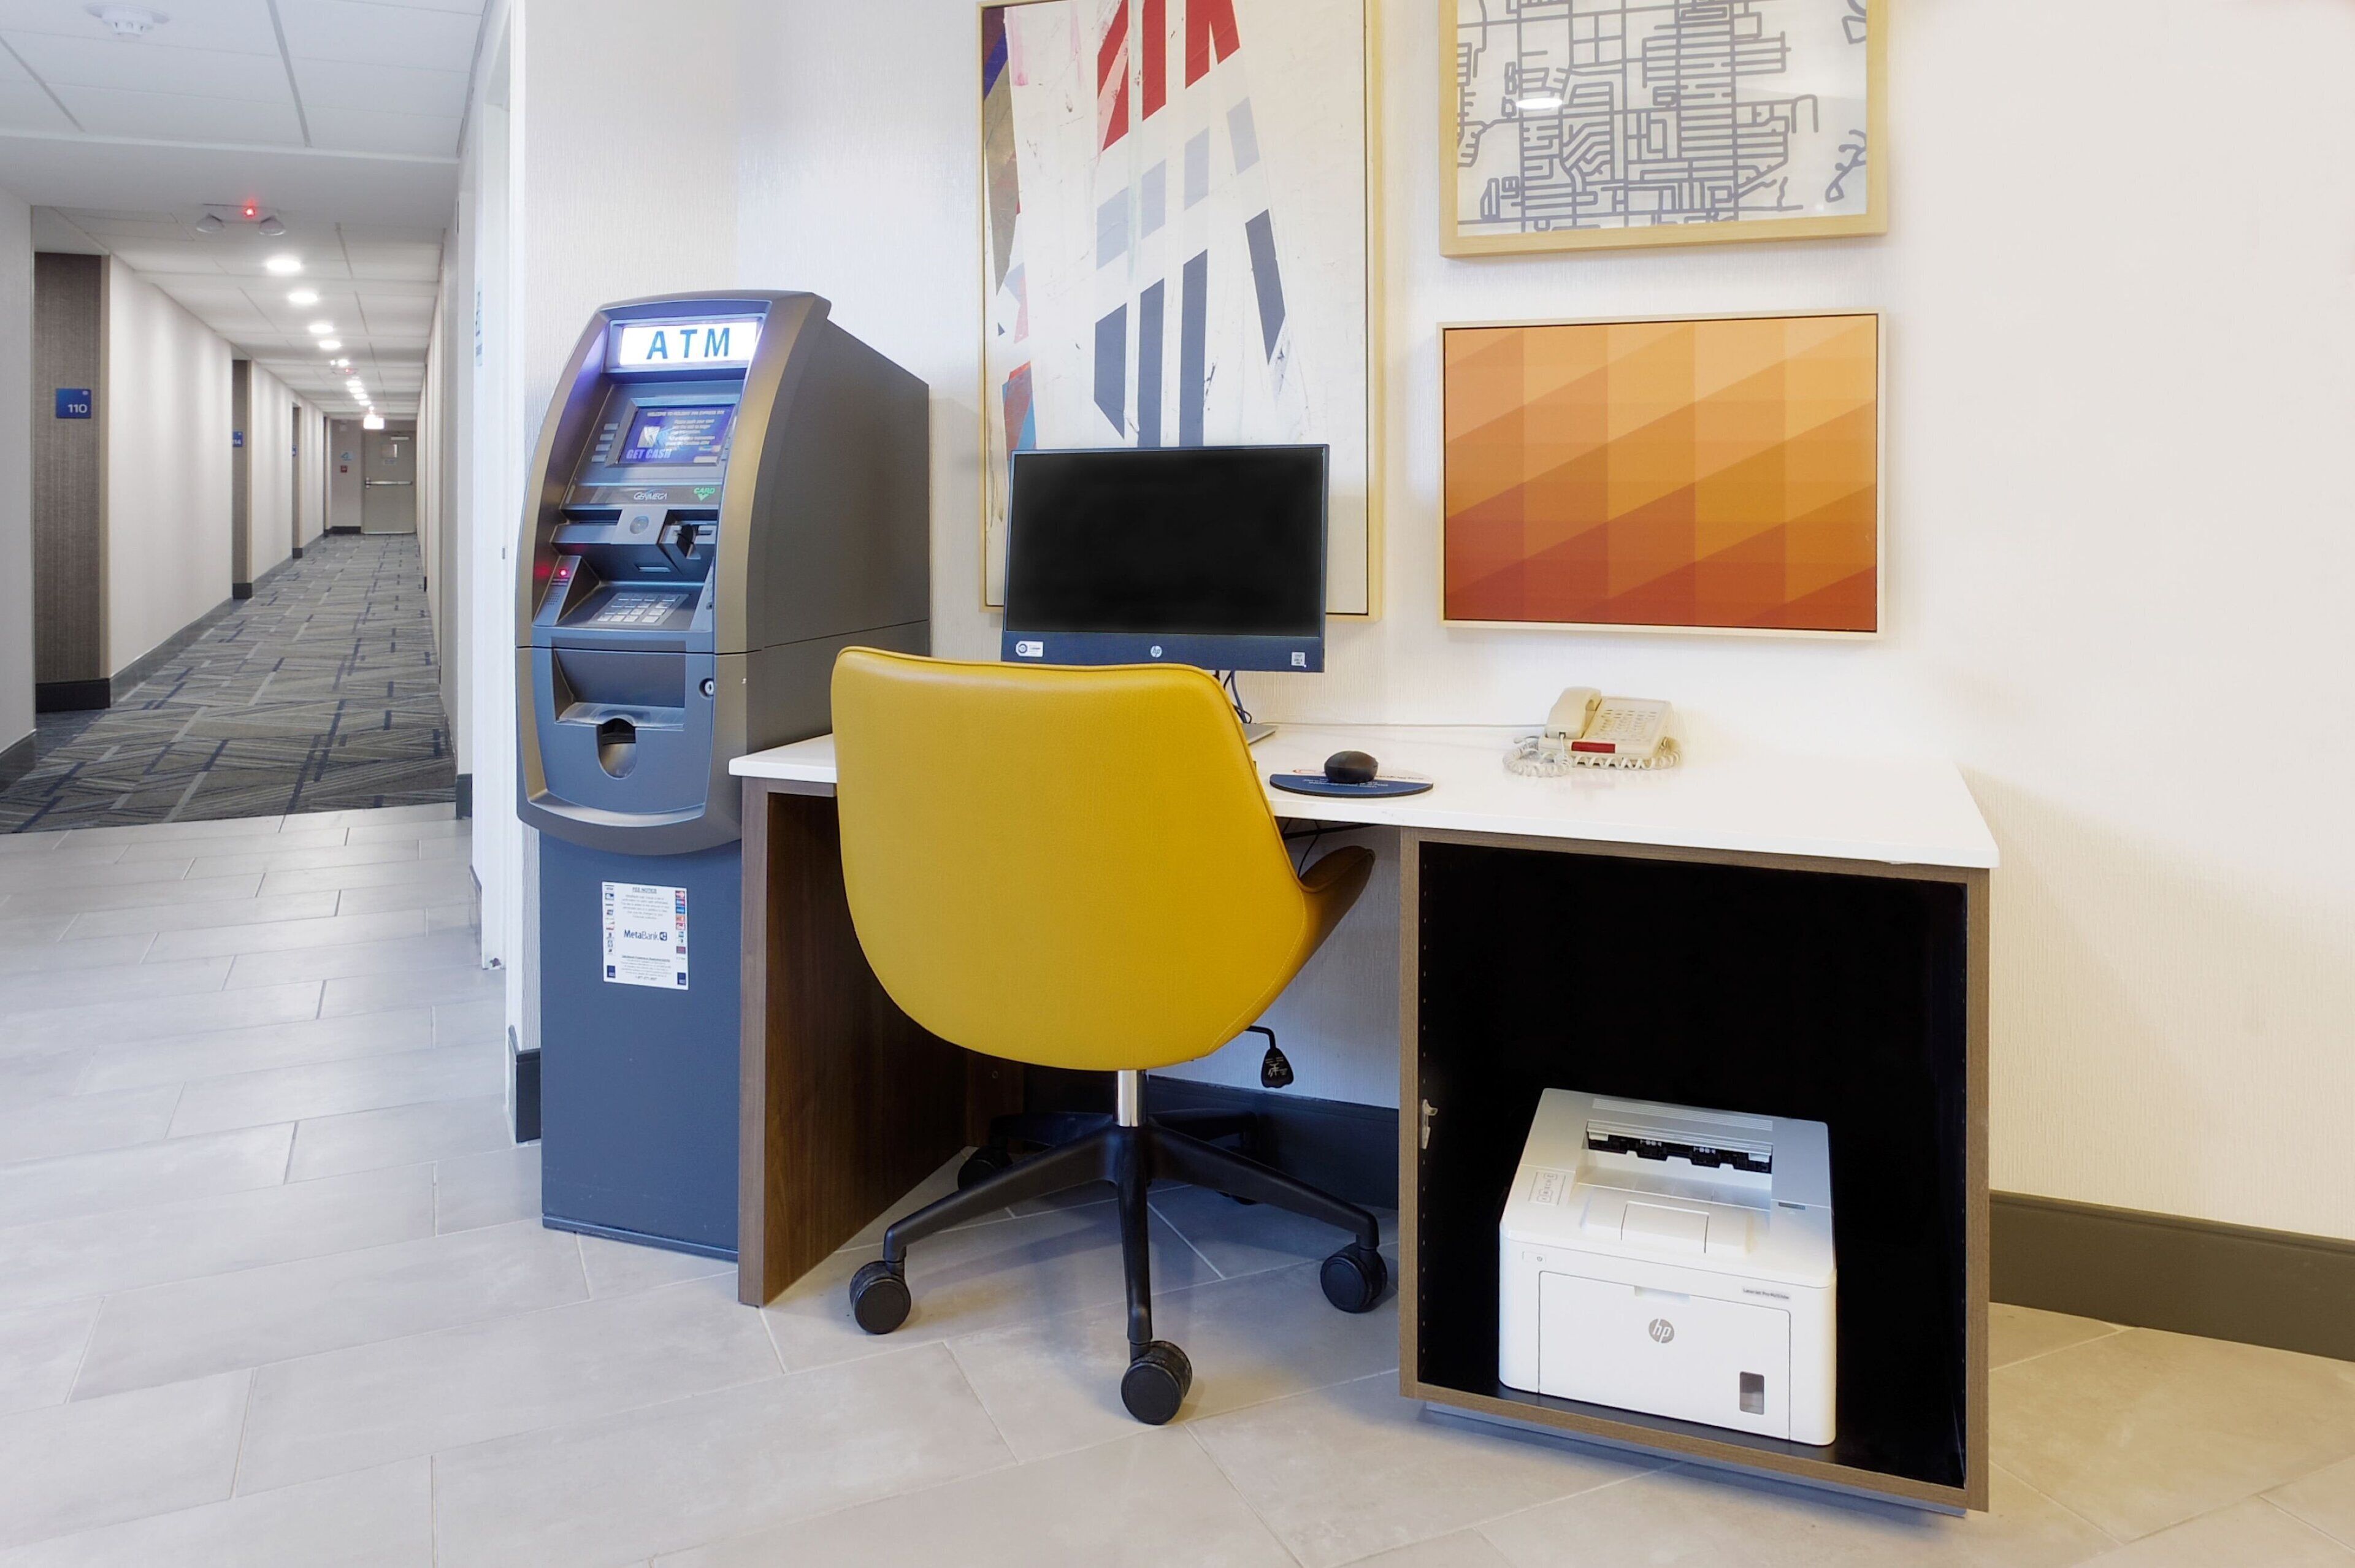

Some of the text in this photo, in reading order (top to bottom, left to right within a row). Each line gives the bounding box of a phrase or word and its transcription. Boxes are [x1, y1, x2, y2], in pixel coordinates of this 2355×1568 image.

[646, 327, 730, 360] ATM
[67, 403, 88, 414] 110
[626, 449, 645, 459] GET
[645, 448, 673, 459] CASH
[624, 929, 658, 940] MetaBank
[1650, 1318, 1673, 1343] hp
